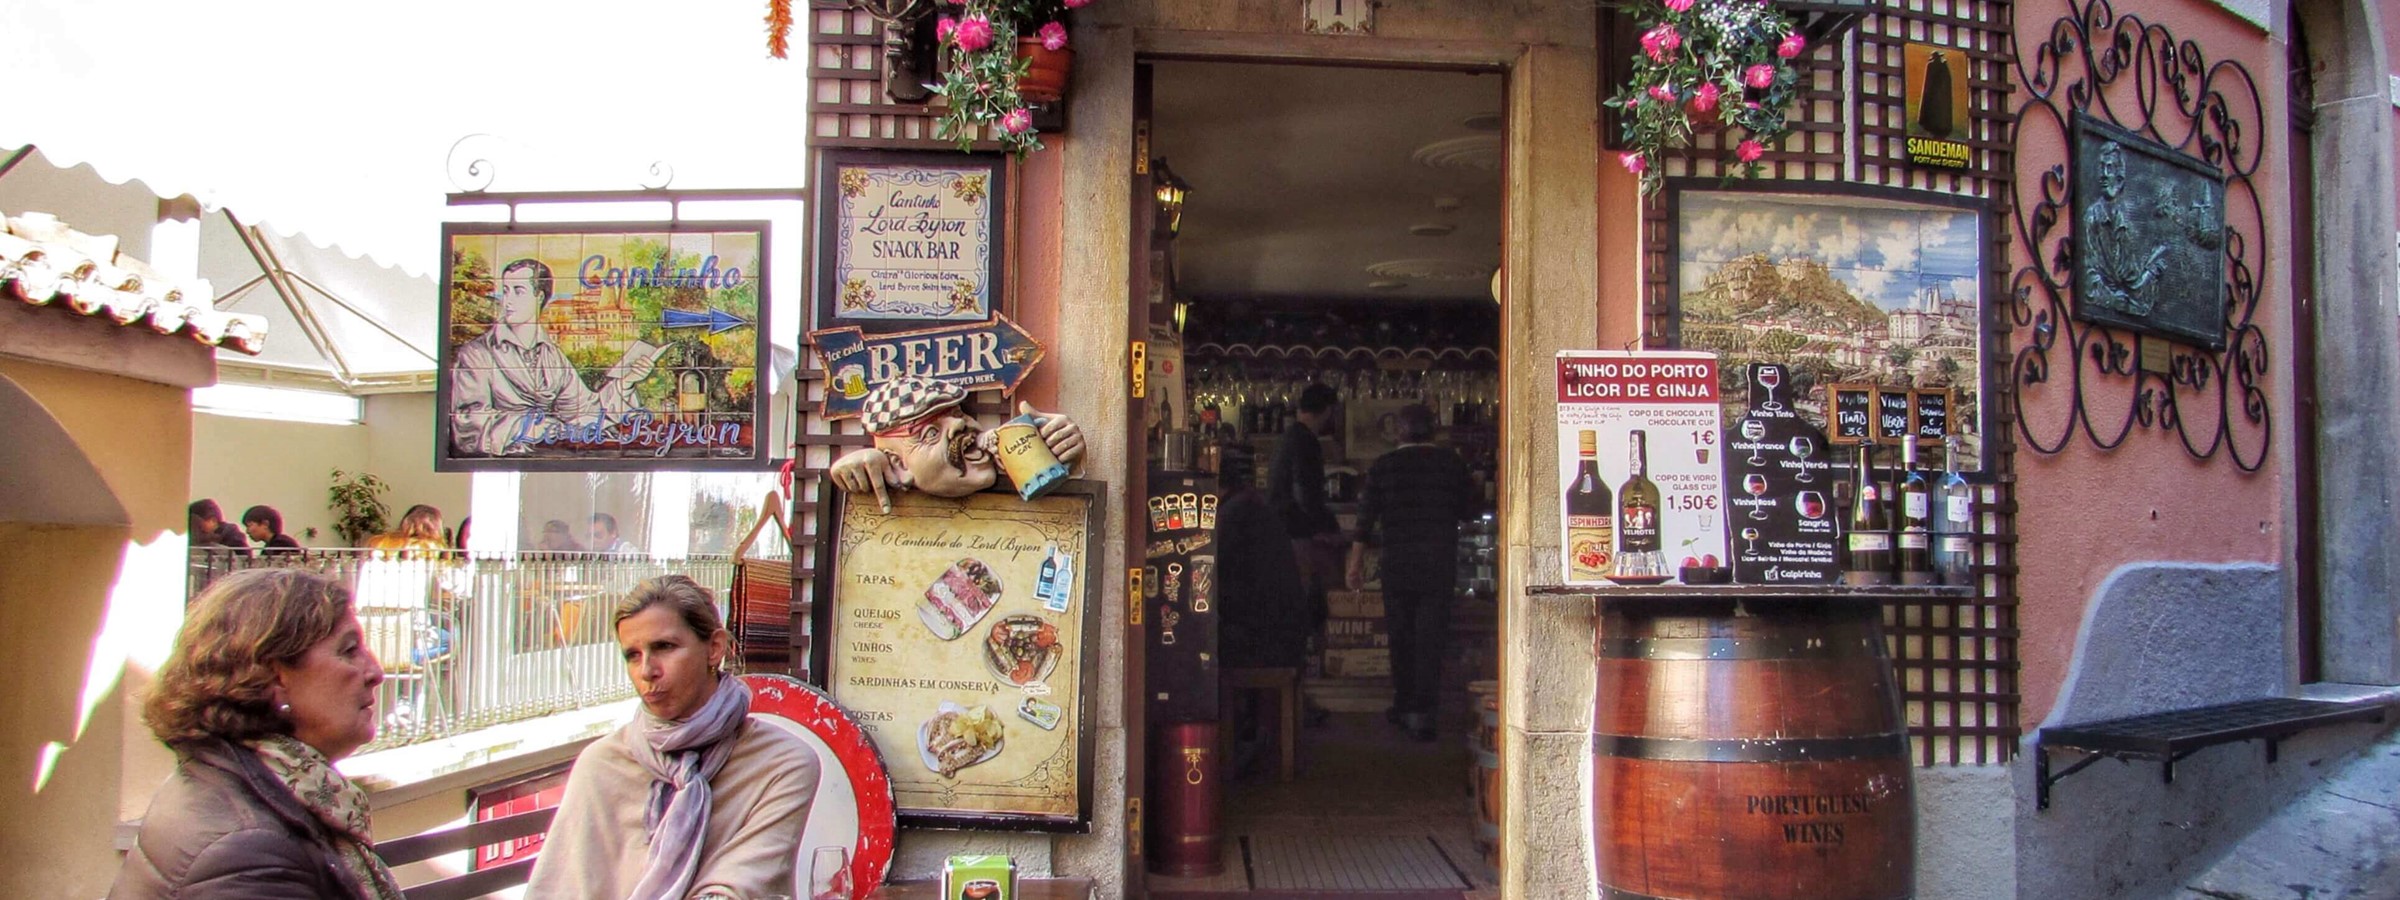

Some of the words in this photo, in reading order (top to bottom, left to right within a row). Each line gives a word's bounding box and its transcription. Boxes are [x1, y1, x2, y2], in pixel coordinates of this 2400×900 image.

[1907, 137, 1969, 160] SANDEMAN
[1913, 155, 1930, 165] PORT
[890, 190, 941, 208] Cantinho
[860, 205, 907, 235] Lord
[908, 212, 967, 239] Byron
[873, 241, 923, 259] SNACK
[927, 241, 960, 259] BAR
[579, 254, 745, 290] Cantinho
[825, 350, 843, 363] Ice
[843, 340, 865, 359] cold
[866, 331, 1004, 385] BEER
[975, 373, 996, 383] HERE
[1622, 364, 1646, 378] DO
[1651, 364, 1708, 378] PORTO
[1567, 383, 1620, 397] LICOR
[1627, 384, 1650, 397] DE
[1656, 384, 1709, 397] GINJA
[1628, 409, 1652, 418] COPO
[1653, 410, 1664, 418] DE
[1665, 410, 1714, 418] CHOCOLATE
[1751, 410, 1774, 418] Vinho
[512, 407, 608, 445] Lord
[621, 407, 741, 456] Byron
[1691, 430, 1715, 445] 1€
[1731, 442, 1754, 450] Vinho
[1757, 442, 1785, 450] Branco
[1780, 460, 1804, 469] Vinho
[1804, 461, 1828, 469] Verde
[1655, 474, 1678, 482] COPO
[1667, 495, 1717, 512] 1,50€
[1733, 498, 1756, 506] Vinho
[1758, 498, 1777, 506] Rosé
[1798, 519, 1830, 528] Sangria
[881, 532, 893, 546] O
[894, 530, 947, 549] Cantinho
[949, 535, 963, 549] do
[967, 535, 1001, 551] Lord
[1000, 536, 1041, 562] Byron
[856, 574, 896, 585] TAPAS
[1780, 569, 1822, 579] Caipirinha
[854, 608, 901, 619] QUEIJOS
[853, 621, 883, 629] CHEESE
[1327, 620, 1374, 635] WINE
[852, 642, 893, 653] VINHOS
[852, 655, 876, 664] WINES
[850, 676, 916, 689] SARDINHAS
[919, 680, 936, 689] EM
[938, 680, 1000, 693] CONSERVA
[1747, 794, 1873, 815] PORTUGUESE
[1783, 822, 1845, 844] WINES
